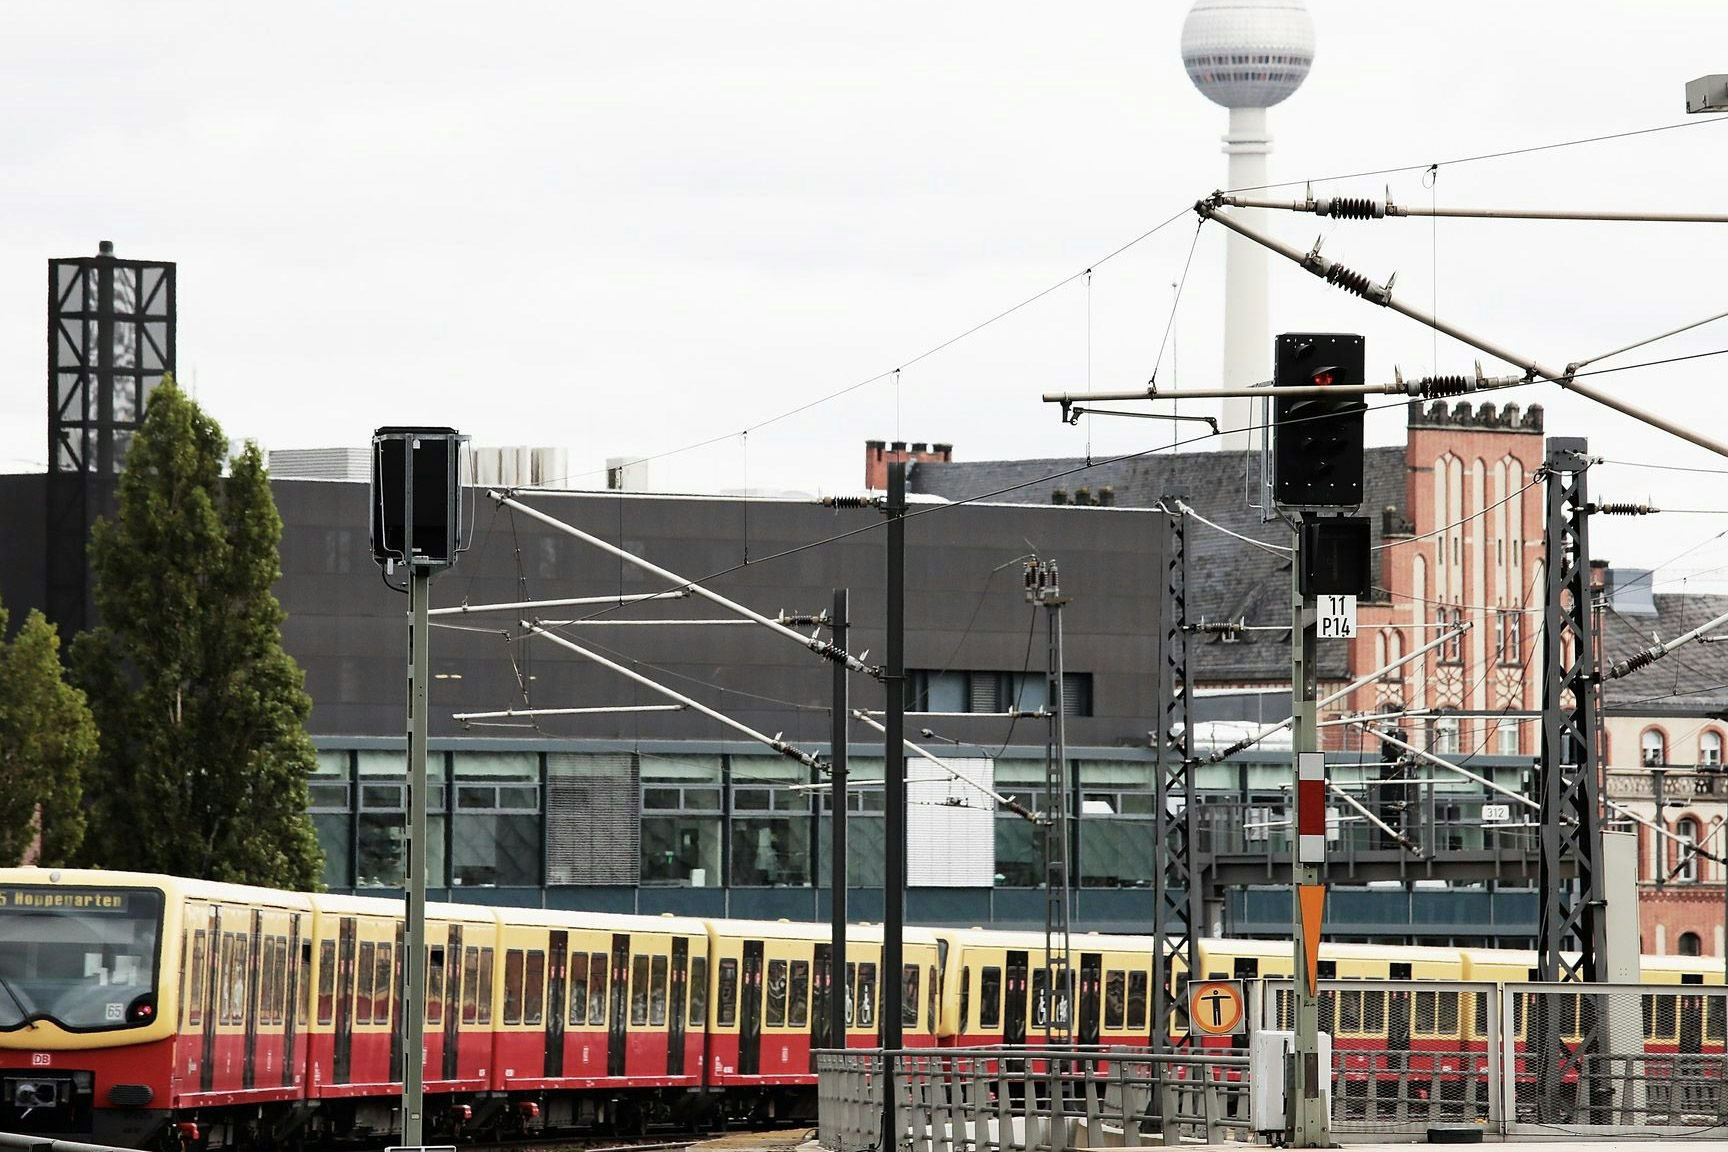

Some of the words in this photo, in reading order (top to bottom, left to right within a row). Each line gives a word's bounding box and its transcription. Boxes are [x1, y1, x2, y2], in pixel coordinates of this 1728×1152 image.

[1330, 596, 1346, 616] 11
[1323, 617, 1350, 636] P14
[1487, 807, 1505, 818] 312
[107, 1004, 121, 1018] 65
[34, 1054, 50, 1064] DB
